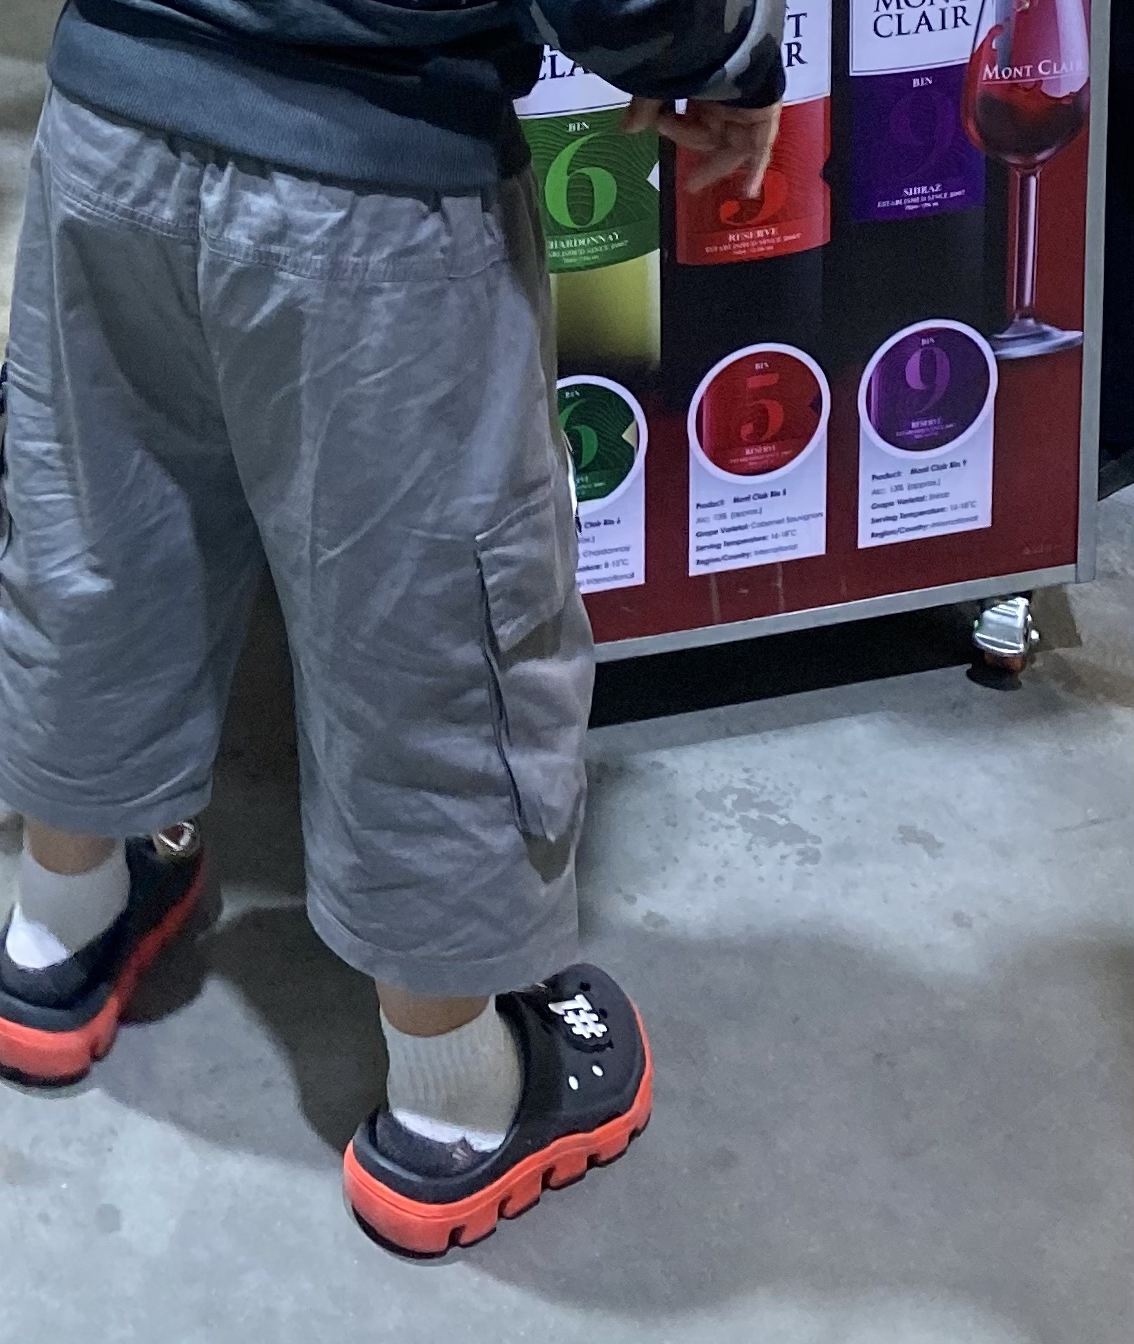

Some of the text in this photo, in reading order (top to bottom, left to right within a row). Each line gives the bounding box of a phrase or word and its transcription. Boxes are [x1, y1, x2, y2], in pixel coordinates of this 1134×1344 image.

[873, 5, 972, 39] CLAIR
[982, 63, 1033, 81] MONT
[912, 76, 933, 88] BIN
[567, 121, 590, 132] BIN
[545, 130, 617, 229] 6
[903, 183, 943, 197] SHIRAZ
[548, 231, 619, 250] HARDONNAY
[729, 227, 778, 242] RESERVE
[906, 346, 951, 414] 9
[741, 372, 784, 443] 5
